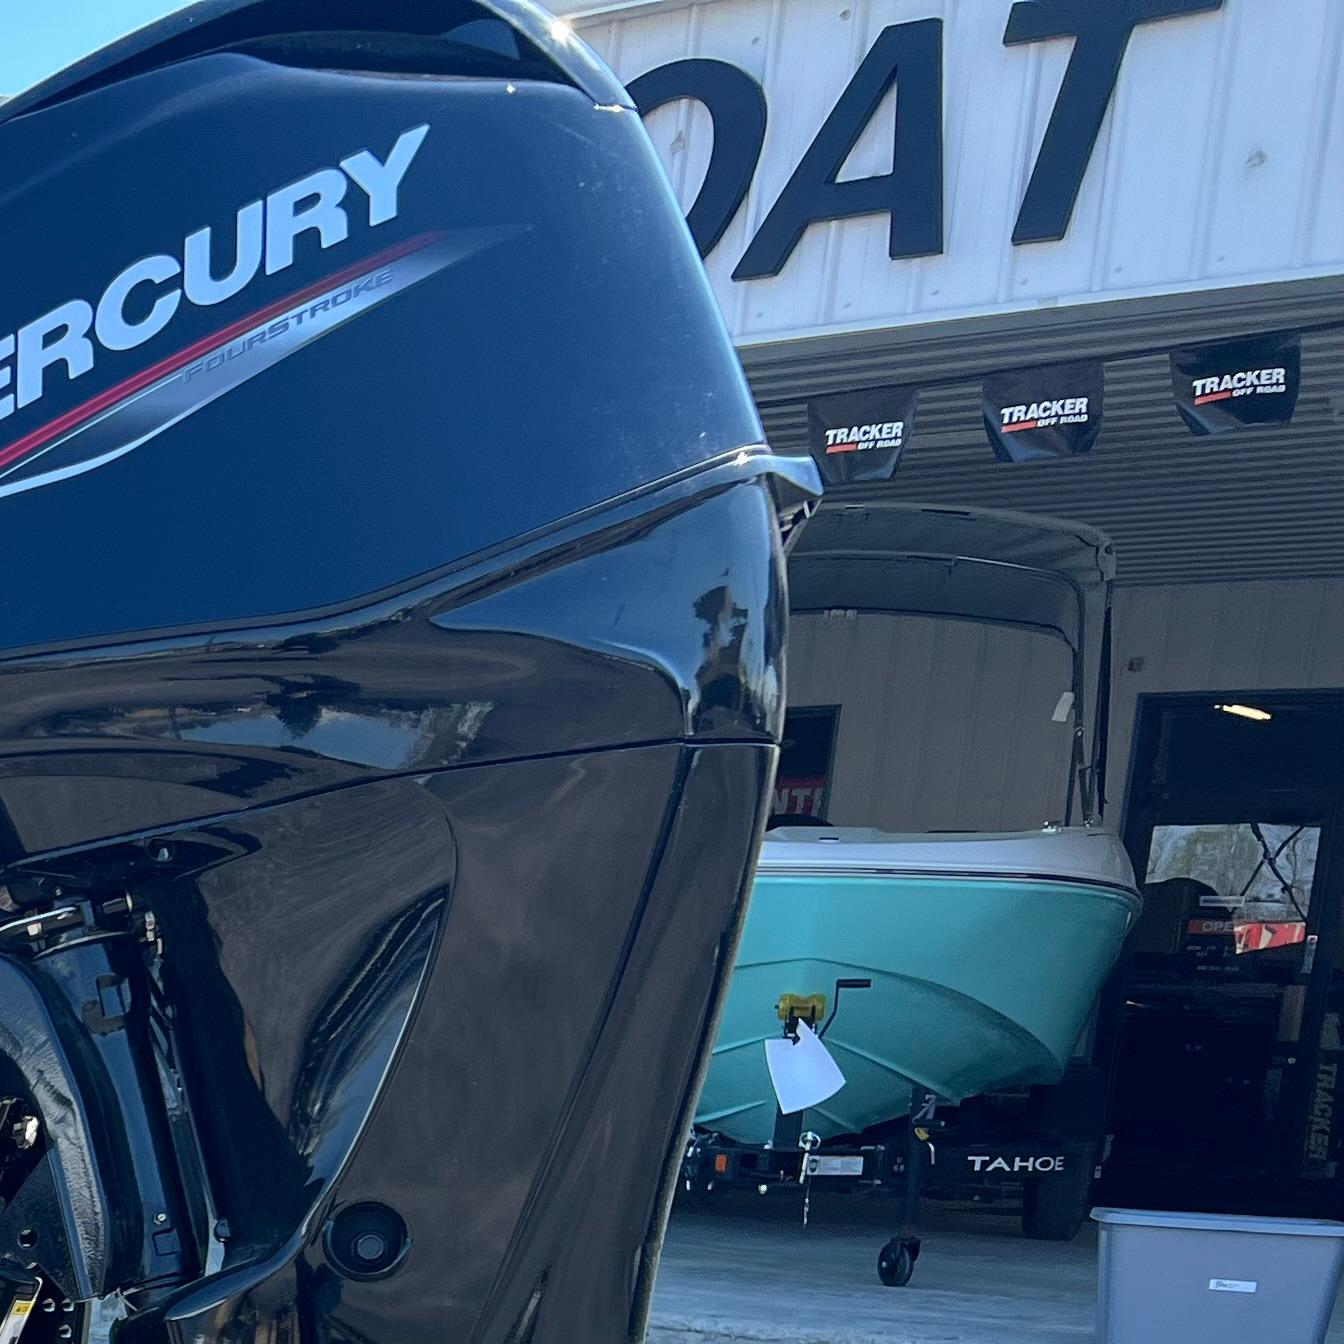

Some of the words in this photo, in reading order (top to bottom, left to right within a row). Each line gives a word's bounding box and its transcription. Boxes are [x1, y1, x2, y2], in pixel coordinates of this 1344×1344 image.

[182, 268, 393, 384] FOURSTROKE
[1192, 367, 1286, 396] TRACKER
[1232, 387, 1254, 397] OFF
[1256, 384, 1286, 394] ROAD
[1000, 397, 1089, 424] TRACKER
[1037, 416, 1058, 427] OFF
[1059, 414, 1089, 424] ROAD
[825, 421, 904, 446] TRACKER
[857, 440, 876, 450] OFF
[876, 438, 903, 449] ROAD
[967, 1156, 1065, 1173] TAHOE
